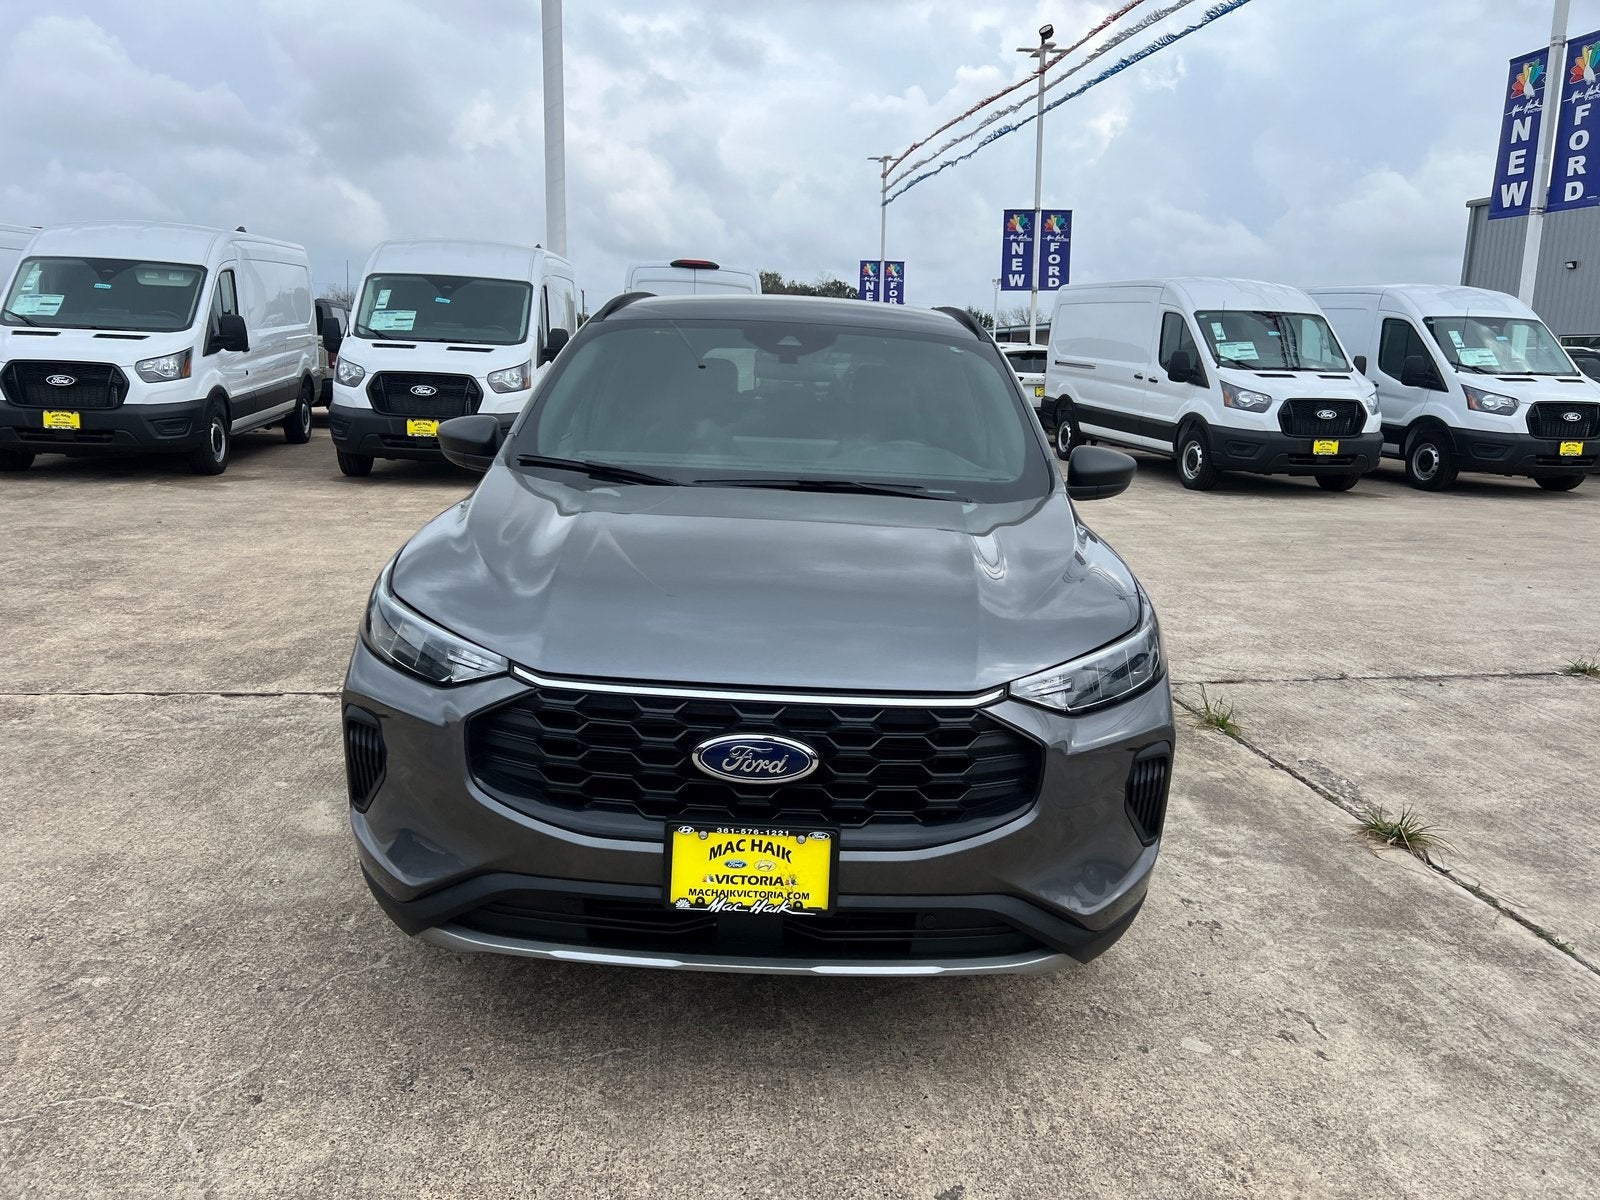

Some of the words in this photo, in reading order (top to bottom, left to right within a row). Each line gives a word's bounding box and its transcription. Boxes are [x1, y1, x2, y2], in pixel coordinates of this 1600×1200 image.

[1501, 116, 1532, 208] NEW
[1564, 103, 1592, 202] FORD
[1009, 242, 1025, 286] NEW
[1047, 242, 1061, 288] FORD
[865, 281, 874, 301] NE
[889, 282, 898, 304] FOR
[722, 745, 789, 774] Ford
[716, 827, 789, 837] 361-576-1221
[708, 838, 746, 861] MAC
[751, 838, 793, 864] HAIK
[726, 860, 746, 869] Ford
[715, 874, 785, 887] VICTORIA
[688, 888, 810, 900] MACHAIKVICTORIA.COM
[708, 896, 748, 913] Mac
[750, 898, 793, 914] Haik
